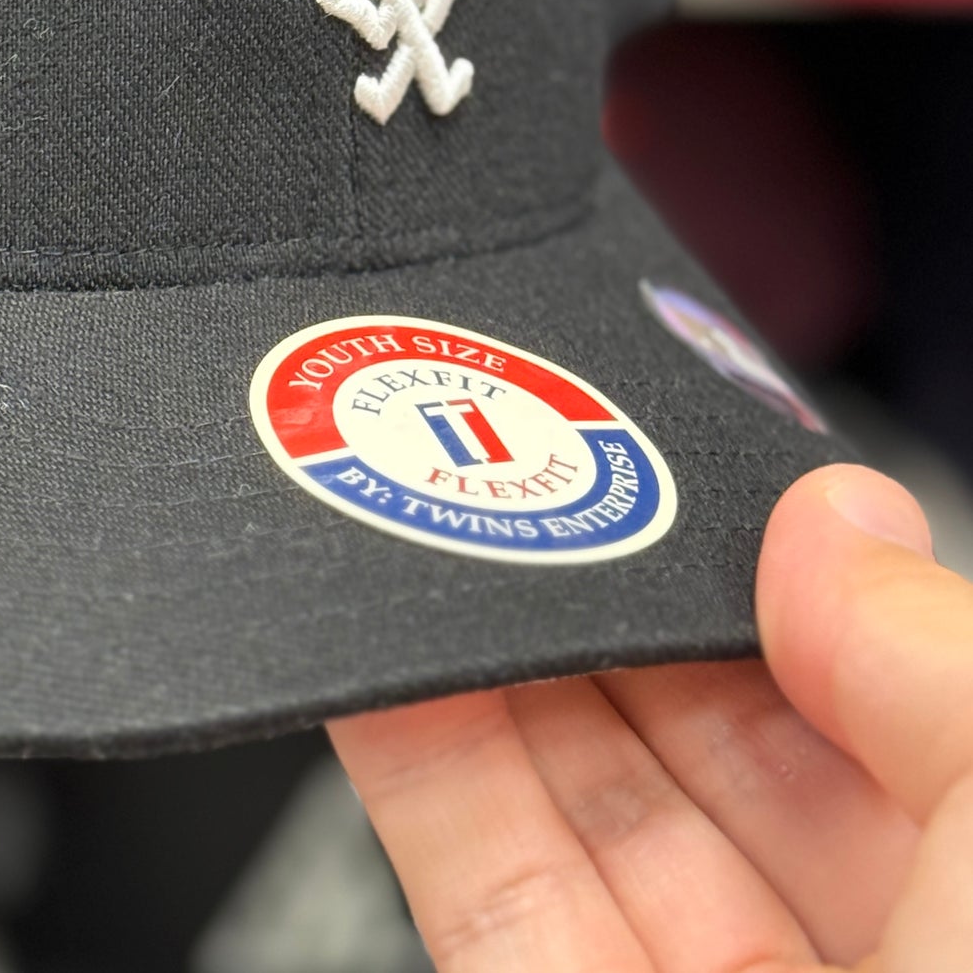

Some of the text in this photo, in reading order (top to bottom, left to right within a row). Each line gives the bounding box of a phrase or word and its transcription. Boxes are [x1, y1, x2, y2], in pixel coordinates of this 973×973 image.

[289, 334, 507, 392] YOUTH SIZE
[351, 369, 507, 416] FLEXFIT
[336, 440, 639, 539] BY: TWINS ENTERPRISE
[425, 454, 578, 499] FLEXFIT
